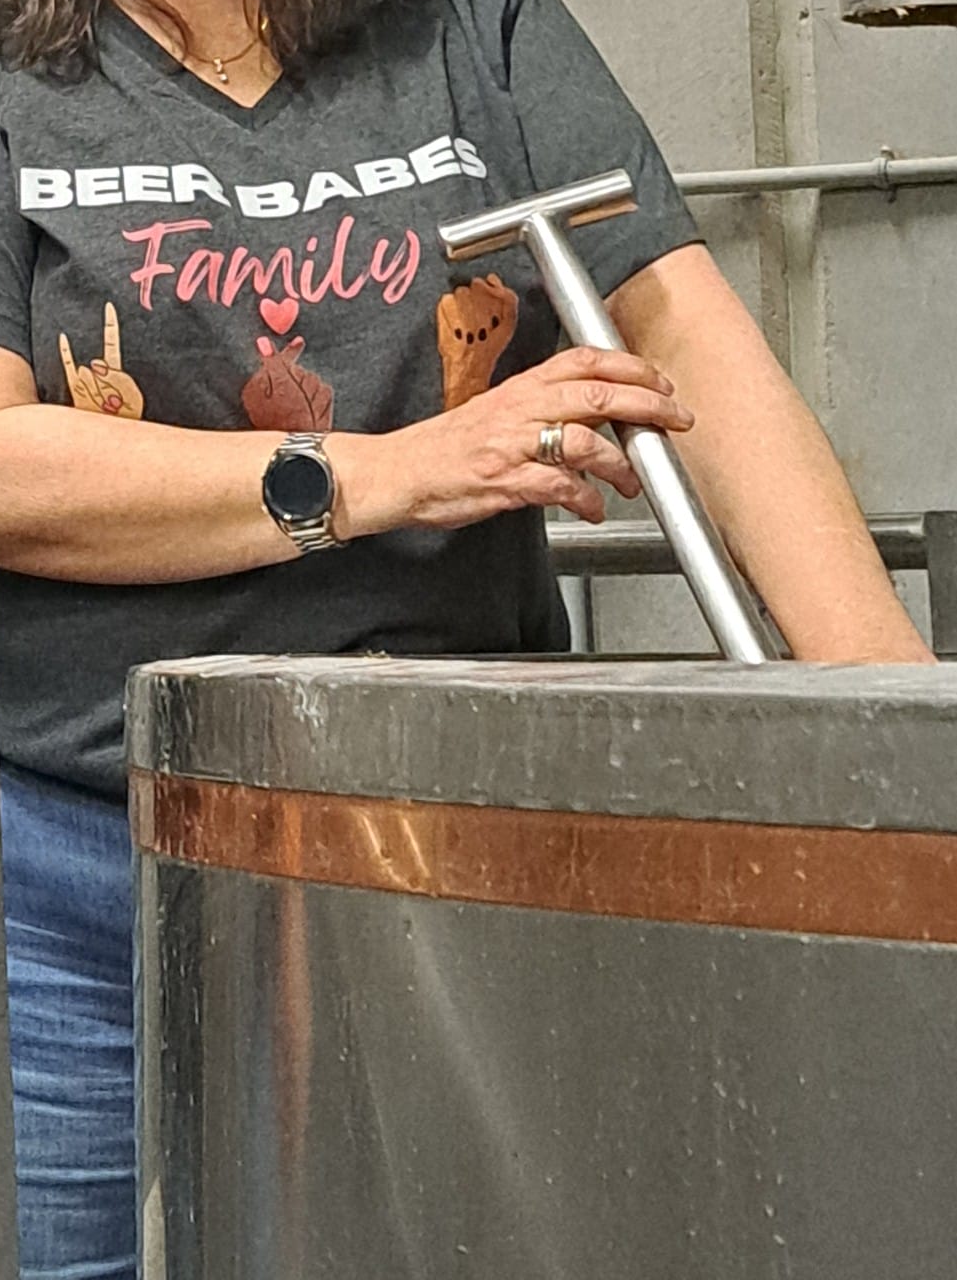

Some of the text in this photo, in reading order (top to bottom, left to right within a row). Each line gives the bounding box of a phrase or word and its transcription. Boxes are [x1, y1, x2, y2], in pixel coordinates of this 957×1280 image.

[19, 136, 488, 218] BEER BABES
[122, 216, 421, 310] Family
